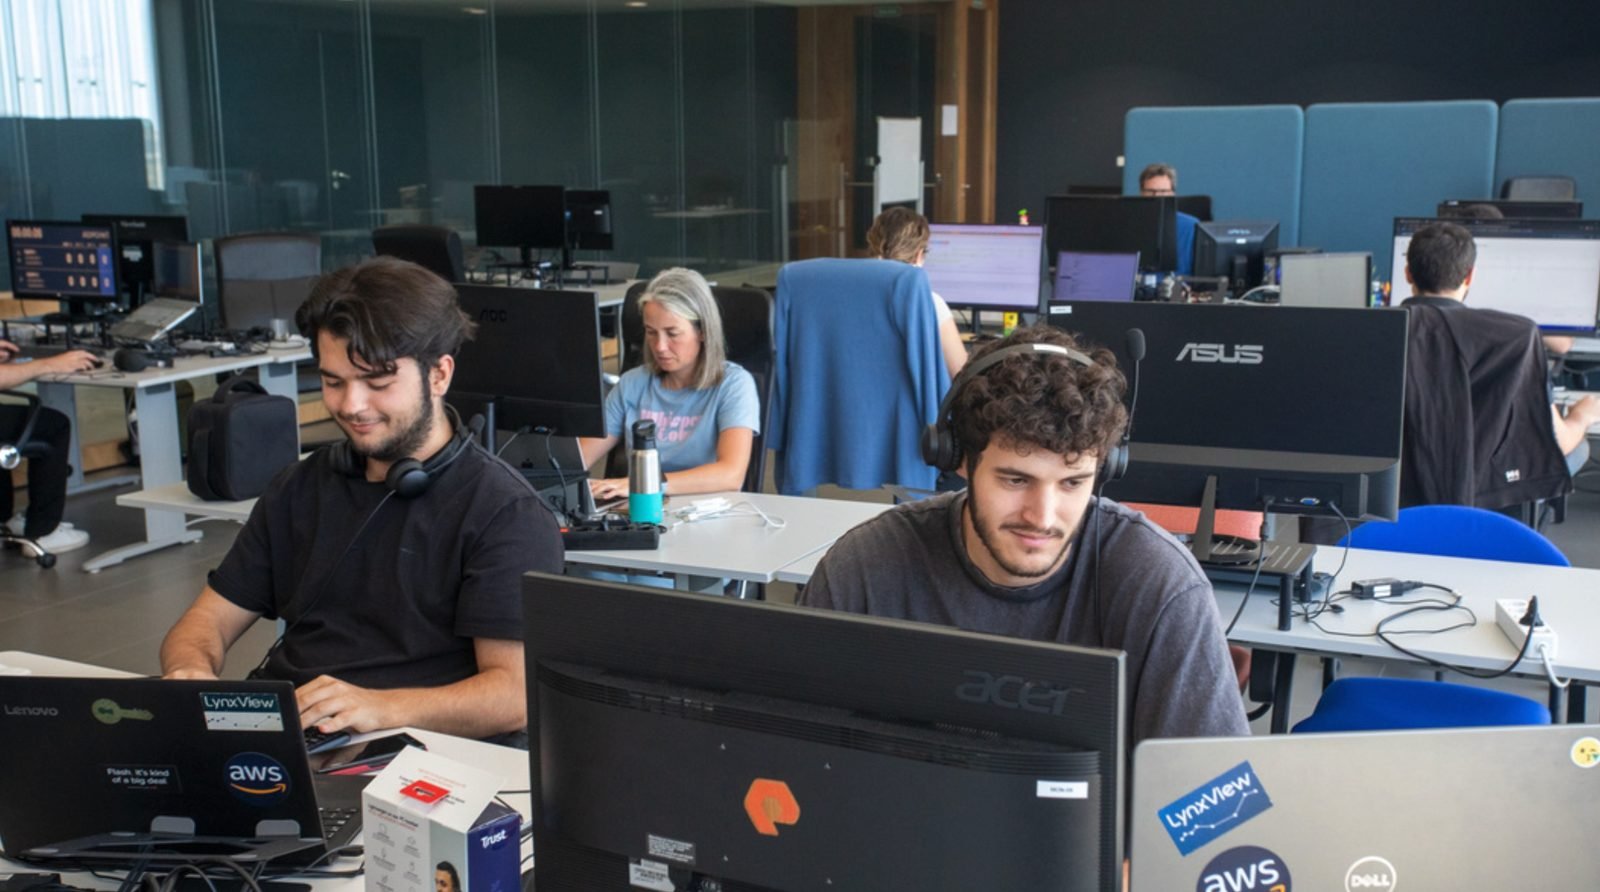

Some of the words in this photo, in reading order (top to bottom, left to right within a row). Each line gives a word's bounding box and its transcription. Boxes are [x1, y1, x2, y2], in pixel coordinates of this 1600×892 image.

[1175, 342, 1264, 365] ASUS
[955, 669, 1088, 716] acer
[4, 703, 59, 716] Lenovo
[204, 695, 275, 709] LynxView
[111, 776, 122, 784] of
[149, 769, 170, 777] kind
[229, 765, 283, 782] aws
[1165, 772, 1251, 828] LynxView
[480, 829, 508, 849] Trust
[1203, 859, 1280, 892] aws
[1351, 874, 1391, 887] DELL
